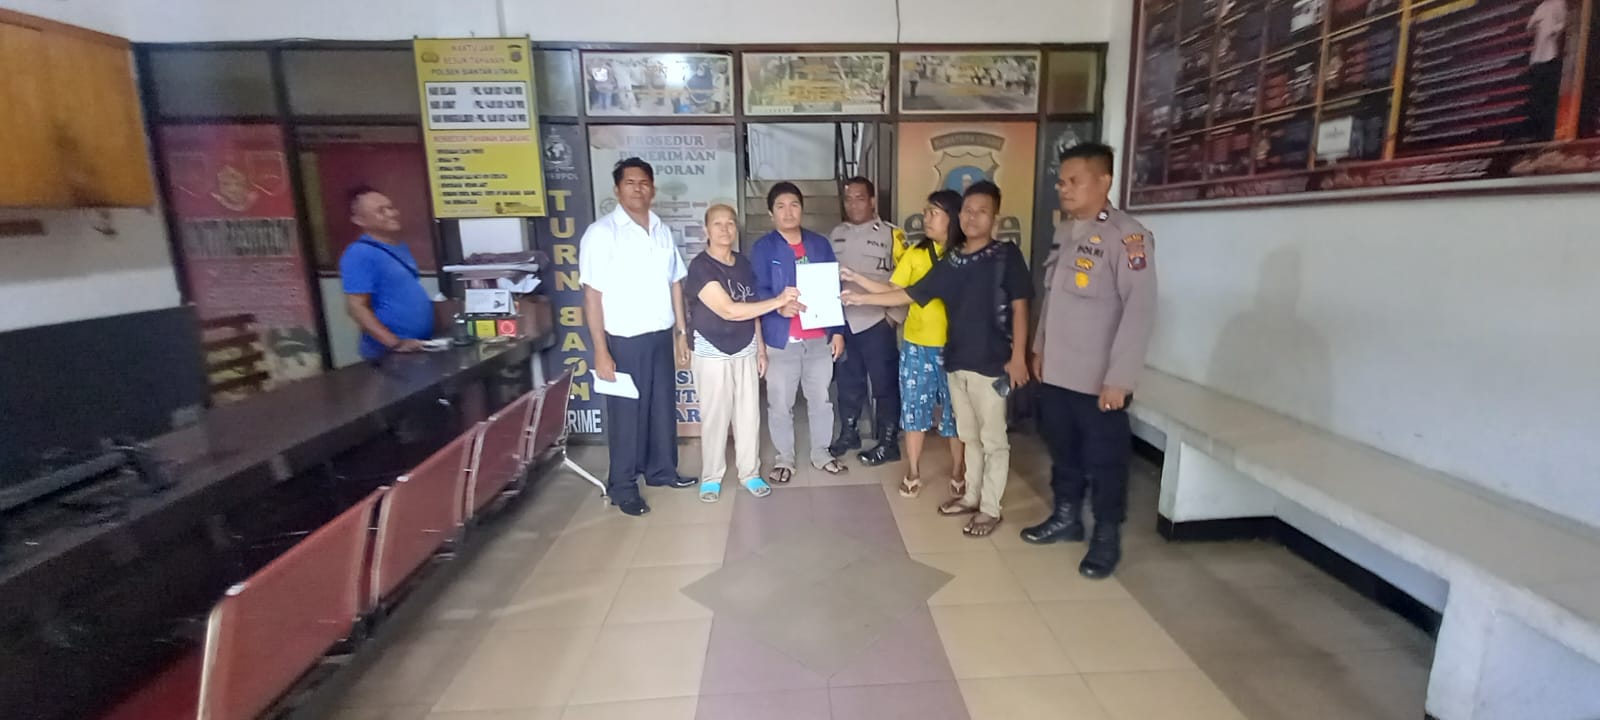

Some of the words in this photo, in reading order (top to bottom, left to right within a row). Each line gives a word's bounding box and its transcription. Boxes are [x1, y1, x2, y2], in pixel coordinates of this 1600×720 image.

[626, 135, 705, 146] PROSEDUR
[655, 164, 705, 176] PORAN
[547, 190, 580, 291] TURN
[865, 239, 888, 249] POLRI
[1076, 244, 1105, 258] POLRI
[567, 409, 602, 433] RIME
